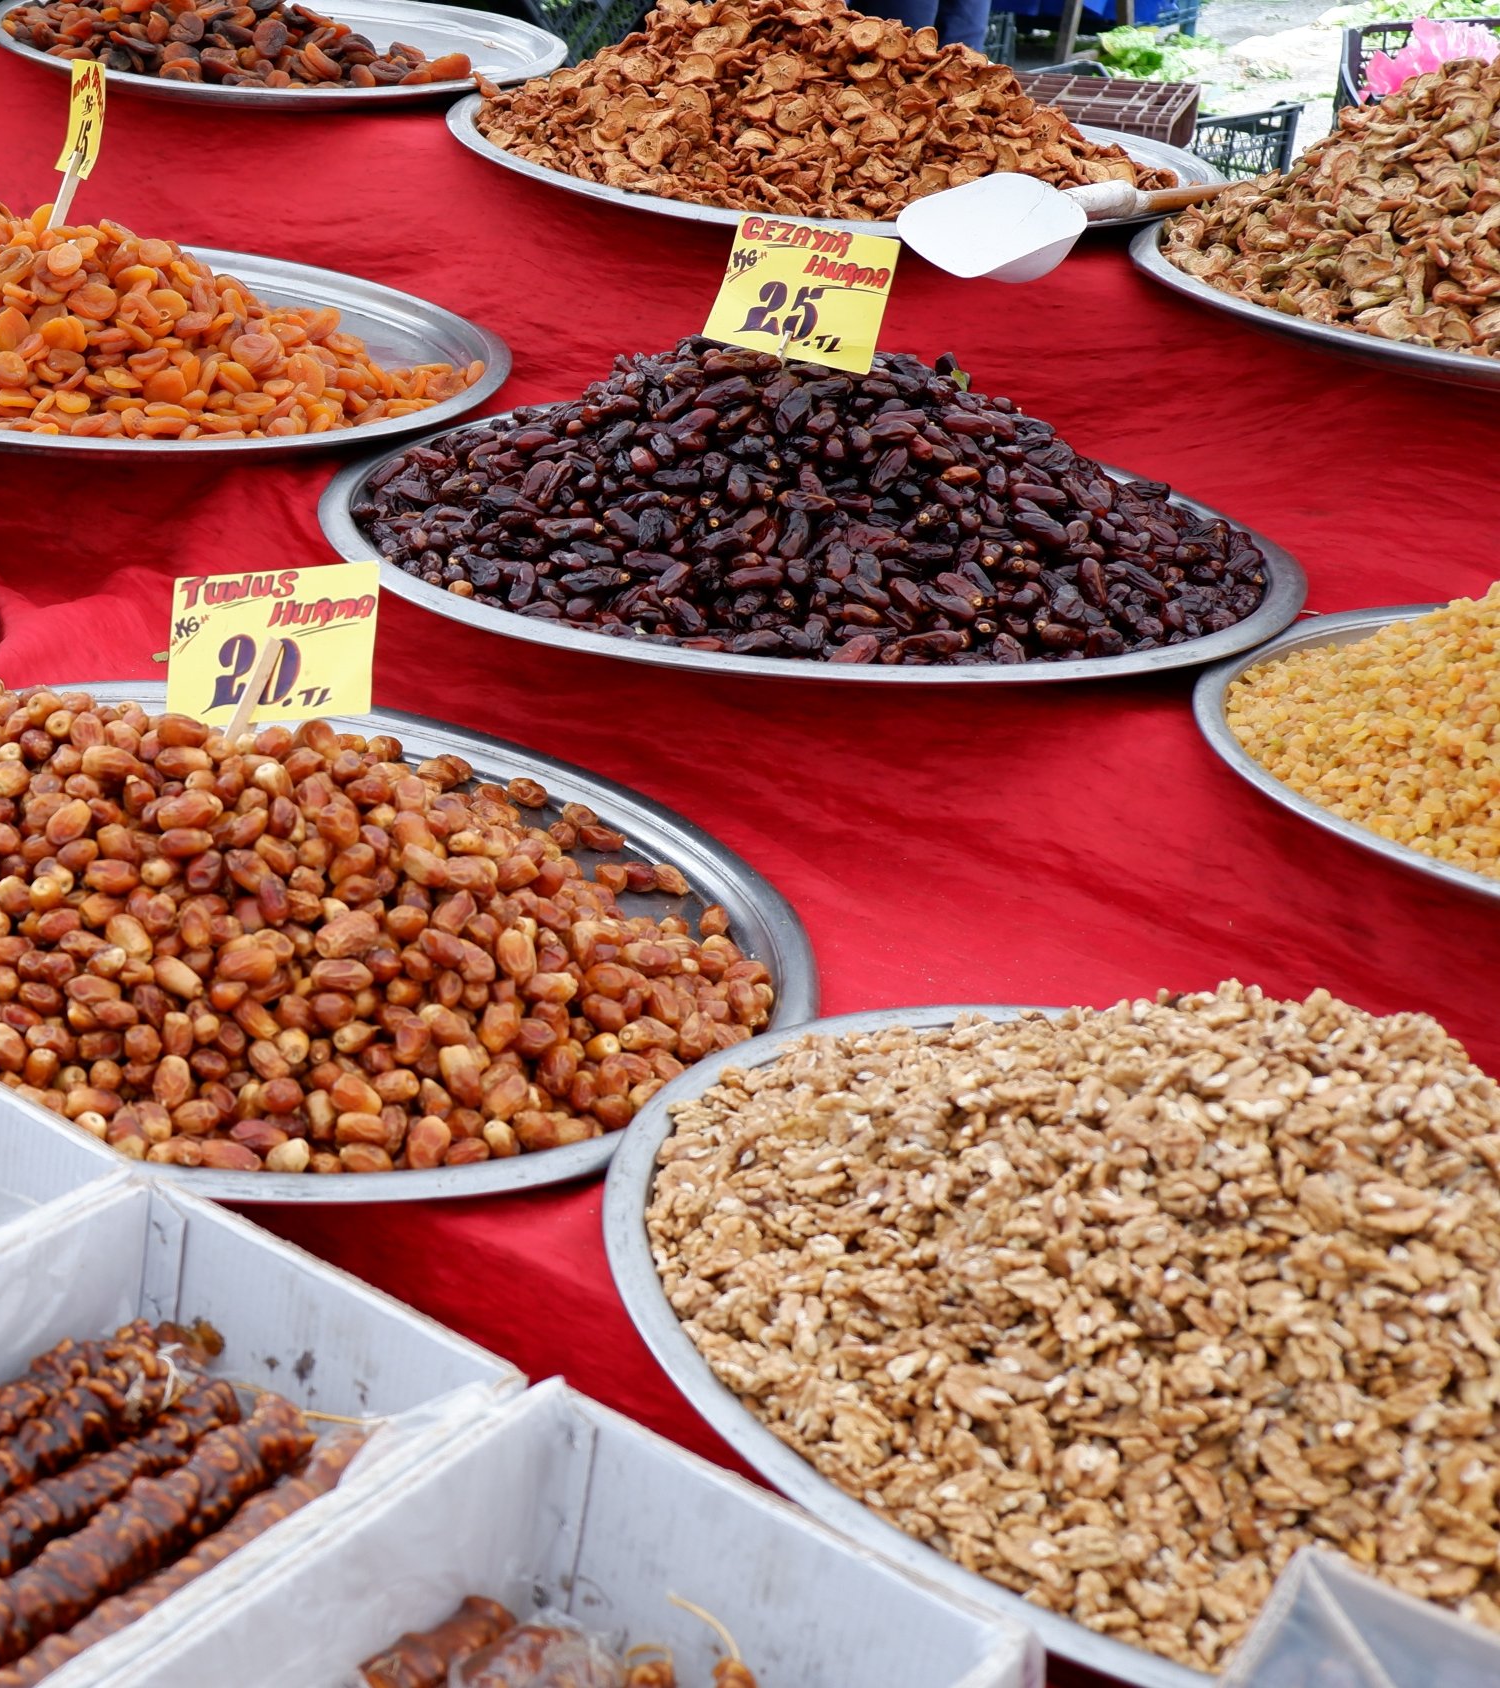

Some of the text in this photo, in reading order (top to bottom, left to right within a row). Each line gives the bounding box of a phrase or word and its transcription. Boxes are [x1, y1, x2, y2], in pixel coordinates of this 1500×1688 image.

[802, 255, 891, 289] HURMA
[179, 570, 299, 610] TUNUS
[267, 594, 376, 628] HURMA
